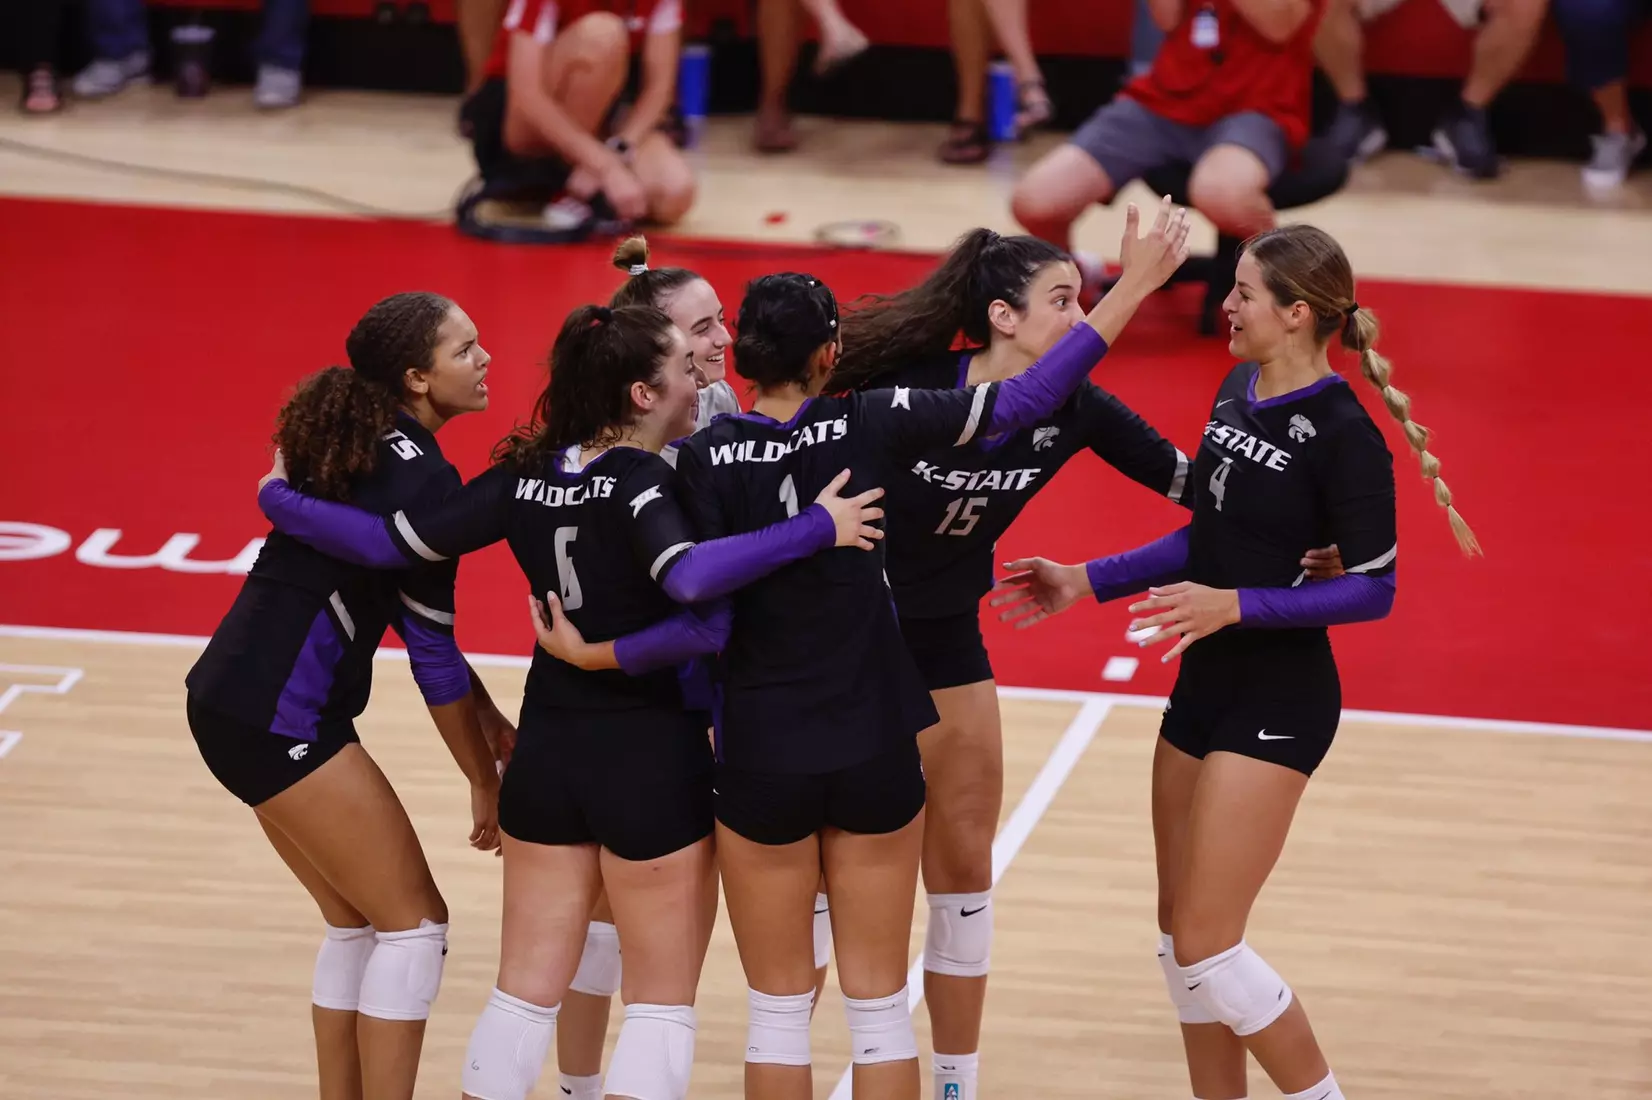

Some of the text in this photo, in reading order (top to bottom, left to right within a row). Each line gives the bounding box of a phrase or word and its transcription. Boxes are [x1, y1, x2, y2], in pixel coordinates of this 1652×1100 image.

[911, 460, 1042, 491] K-STATE
[1209, 456, 1234, 512] 4
[934, 496, 989, 537] 15
[554, 525, 583, 612] 6
